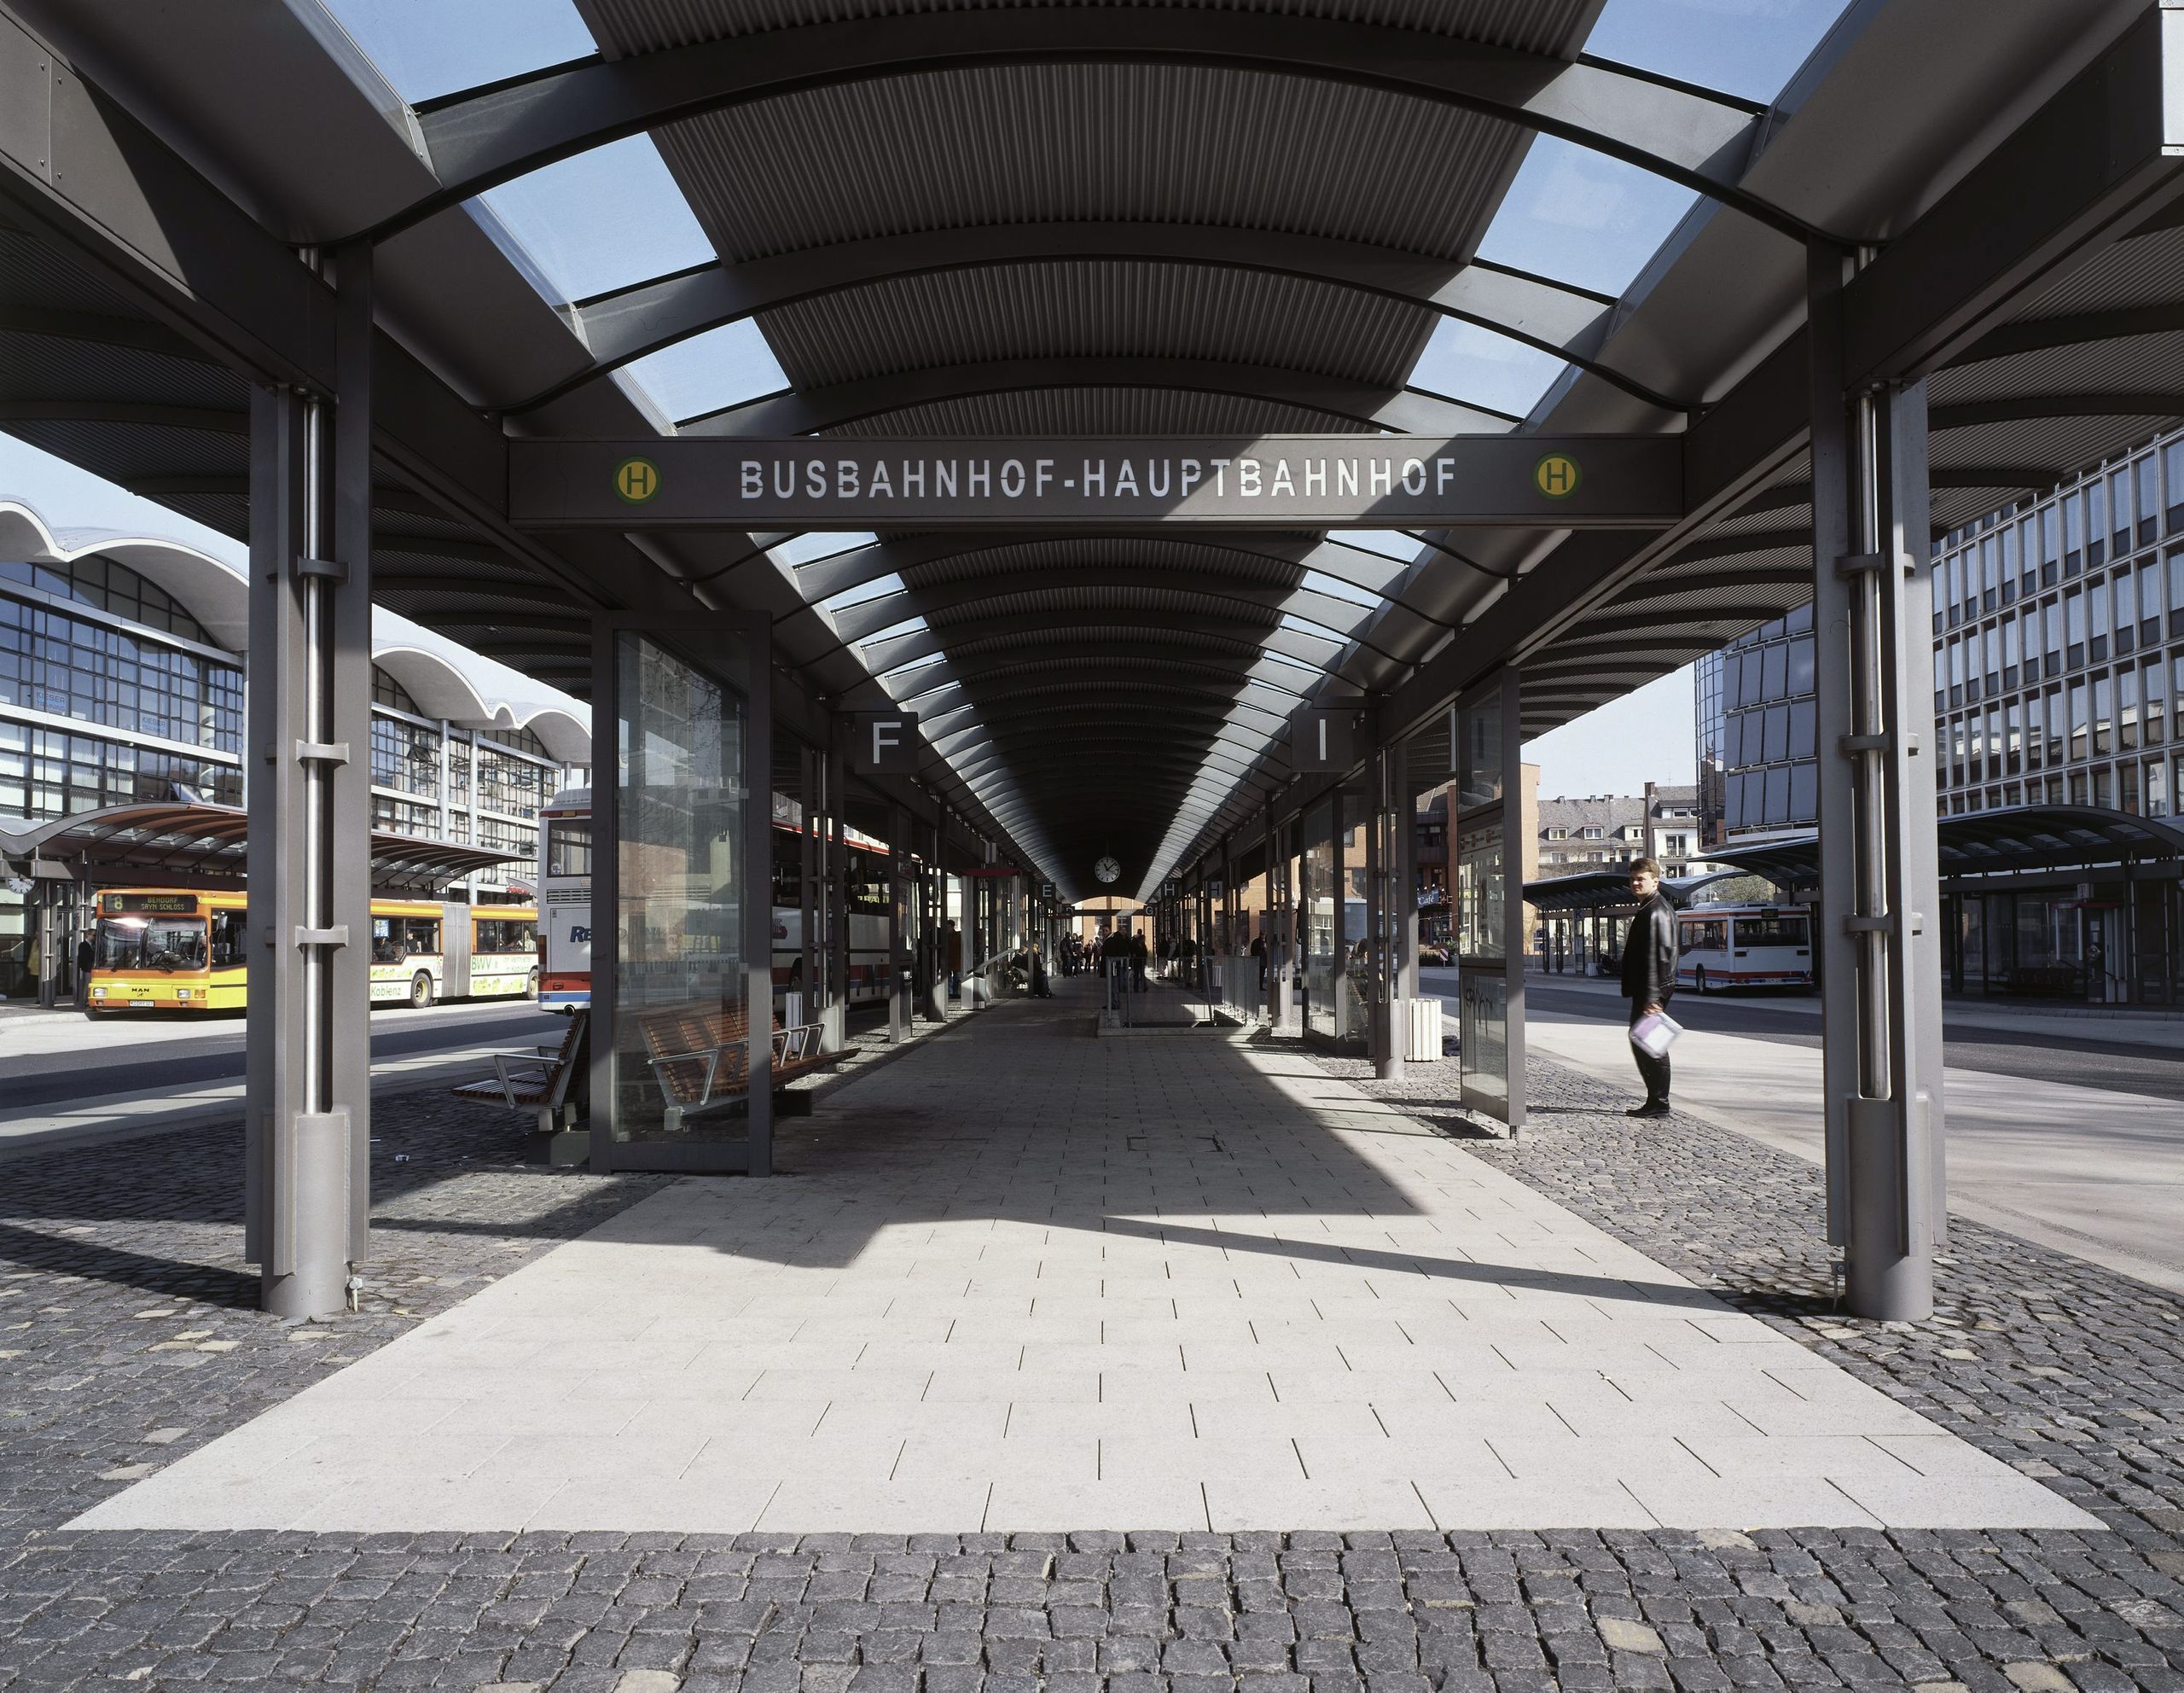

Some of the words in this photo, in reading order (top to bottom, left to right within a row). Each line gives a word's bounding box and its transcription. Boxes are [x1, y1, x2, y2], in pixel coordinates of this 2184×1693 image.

[741, 458, 1455, 498] BUSBAHNHOF-HAUPTBAHNHOF
[873, 722, 901, 764] F
[1043, 884, 1052, 898] E
[1165, 883, 1175, 896] H
[1417, 894, 1435, 905] Café
[1146, 906, 1153, 916] G
[471, 956, 492, 970] BWV
[370, 986, 402, 997] Koblenz
